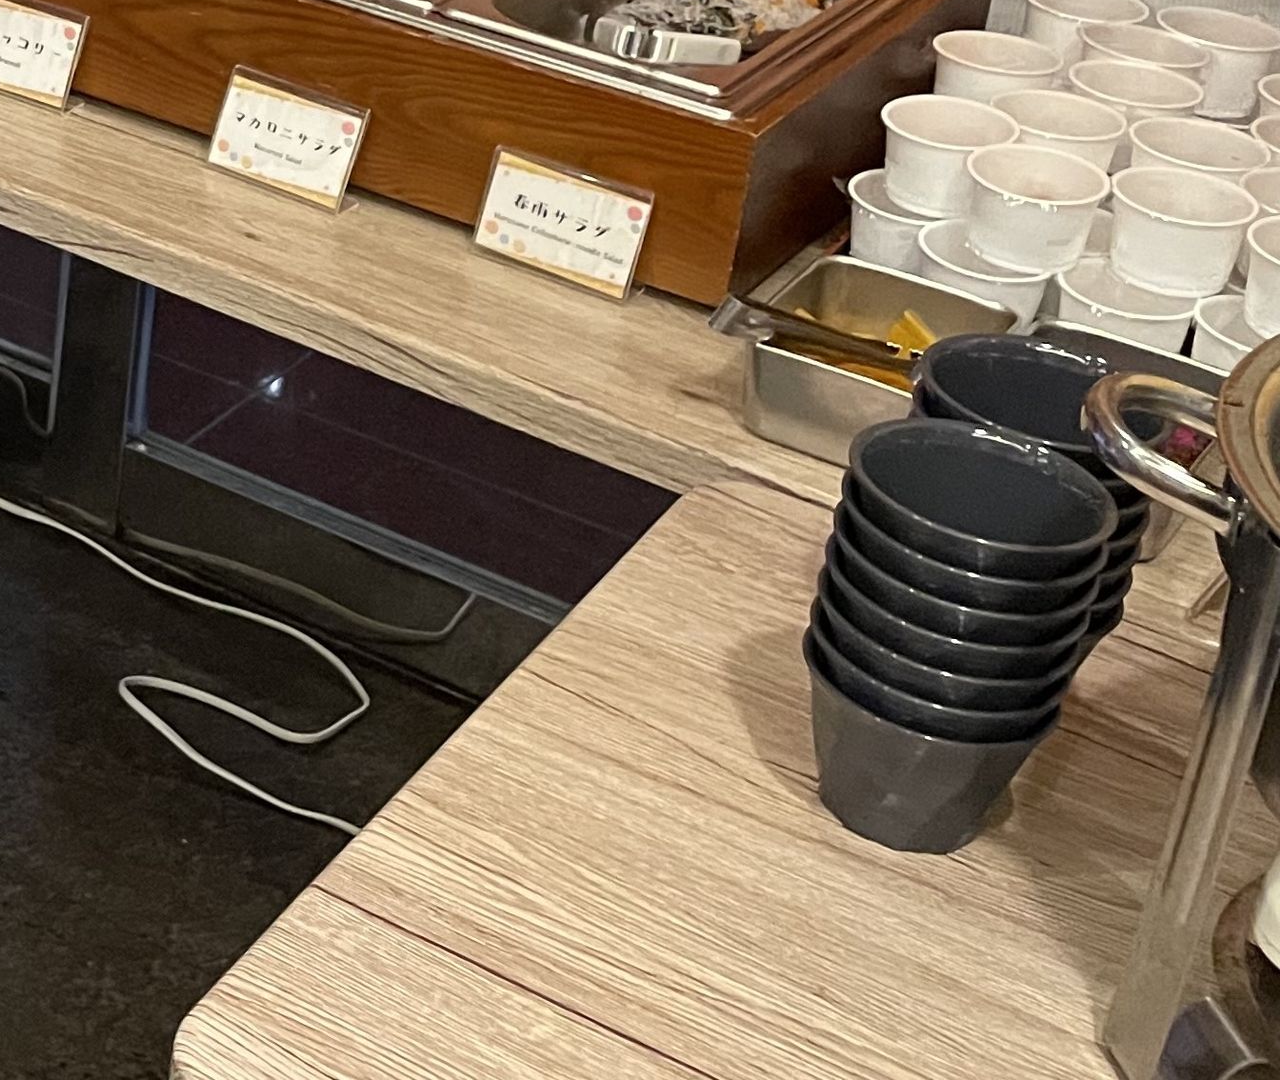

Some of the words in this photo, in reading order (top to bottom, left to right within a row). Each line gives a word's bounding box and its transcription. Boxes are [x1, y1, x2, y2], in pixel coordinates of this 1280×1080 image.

[235, 110, 342, 156] マカロニサラダ
[514, 193, 611, 238] 春雨サラダ
